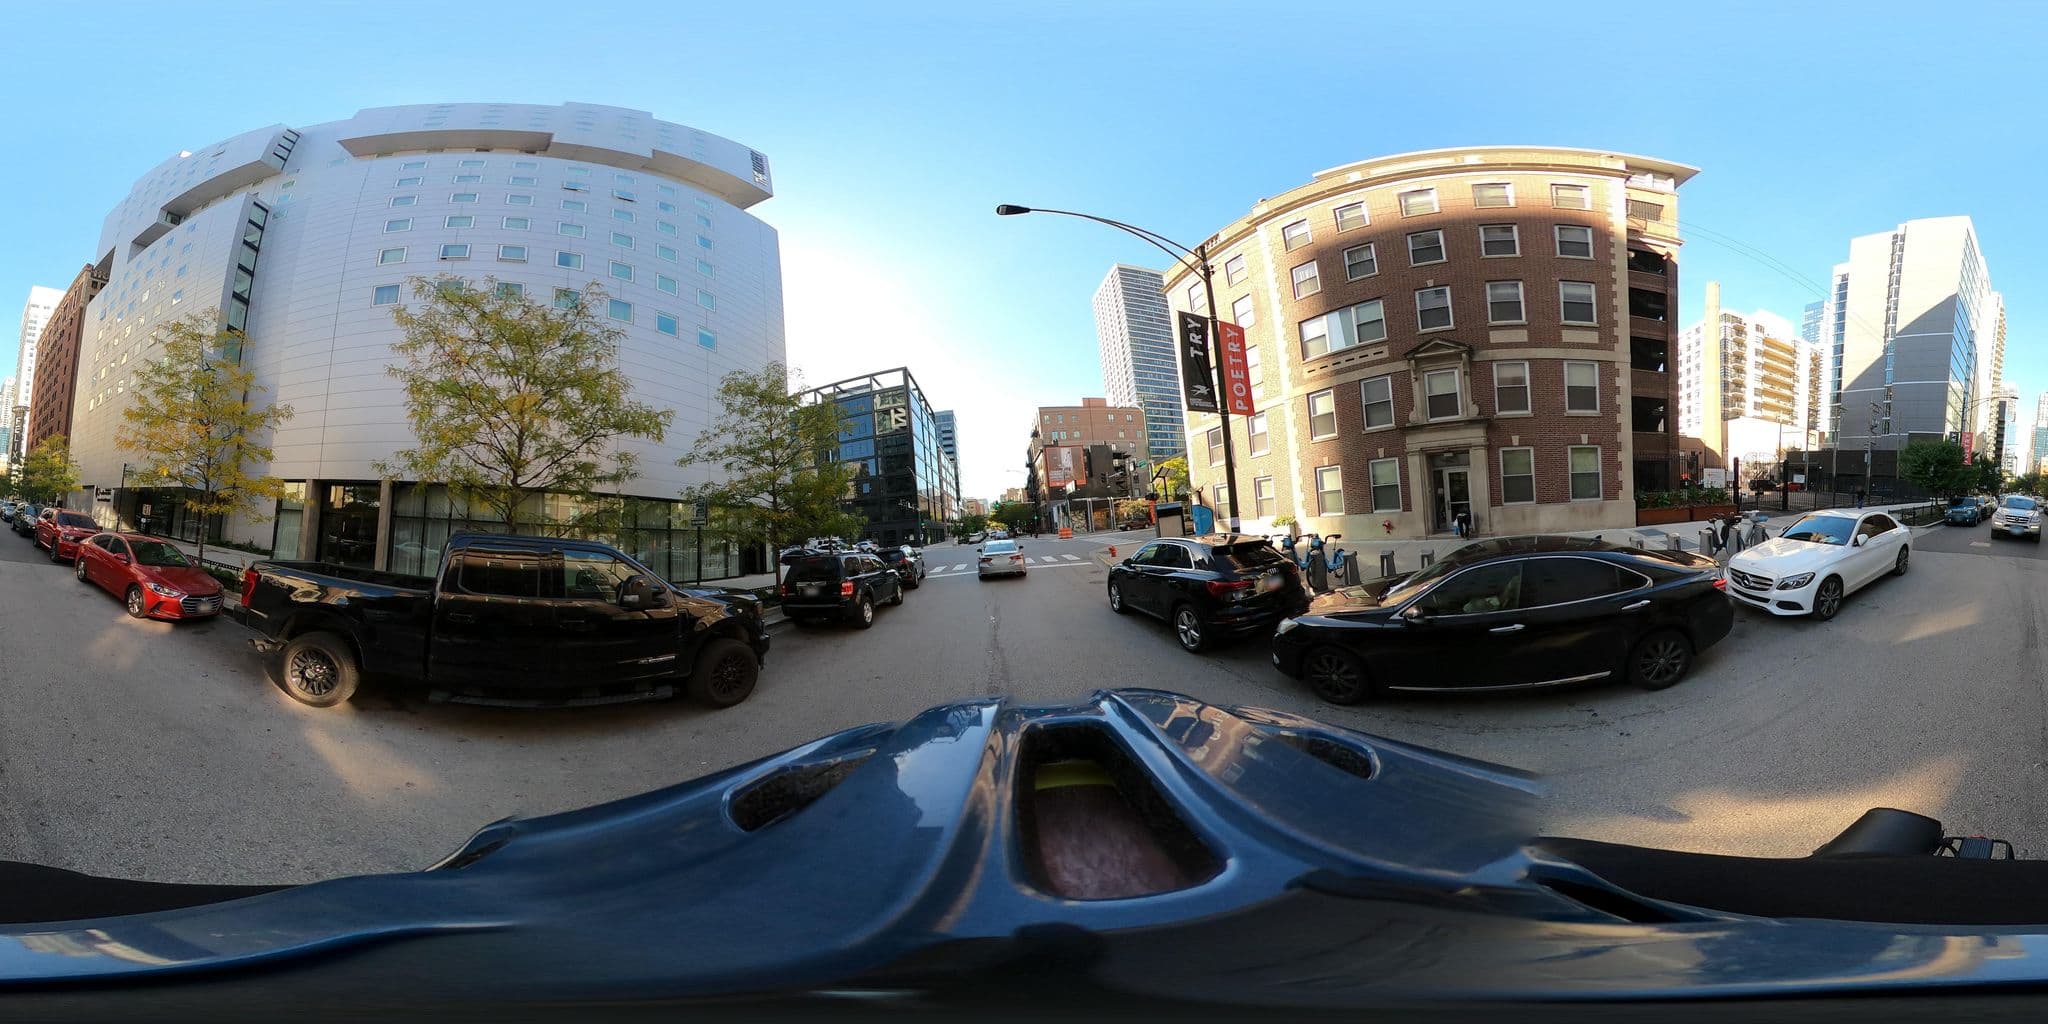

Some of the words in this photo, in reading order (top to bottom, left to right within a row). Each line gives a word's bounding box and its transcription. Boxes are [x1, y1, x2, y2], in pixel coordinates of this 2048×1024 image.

[1187, 317, 1204, 358] TRY
[1226, 327, 1248, 410] POETRY
[12, 416, 21, 460] FELIX
